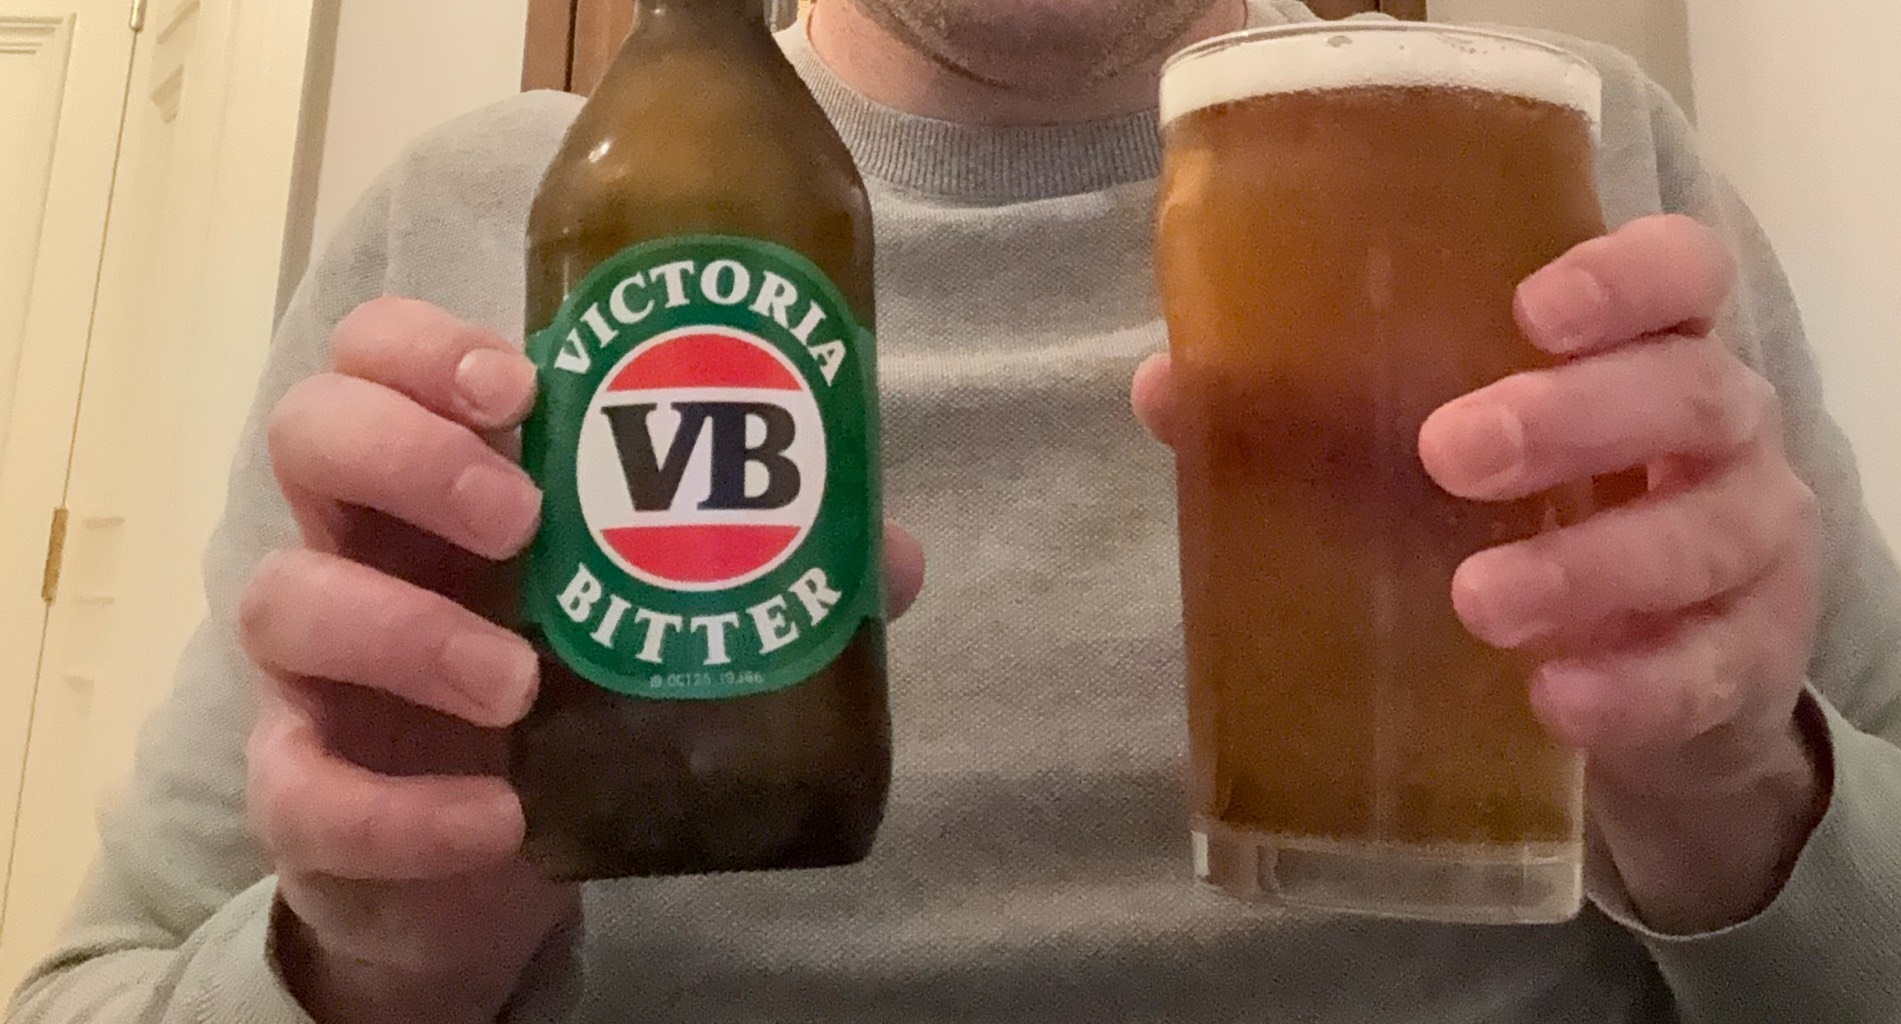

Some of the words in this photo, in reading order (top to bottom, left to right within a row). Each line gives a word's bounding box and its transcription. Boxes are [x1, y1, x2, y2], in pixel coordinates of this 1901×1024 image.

[554, 259, 847, 386] VICTORIA
[600, 401, 801, 513] VB
[556, 562, 843, 665] BITTER
